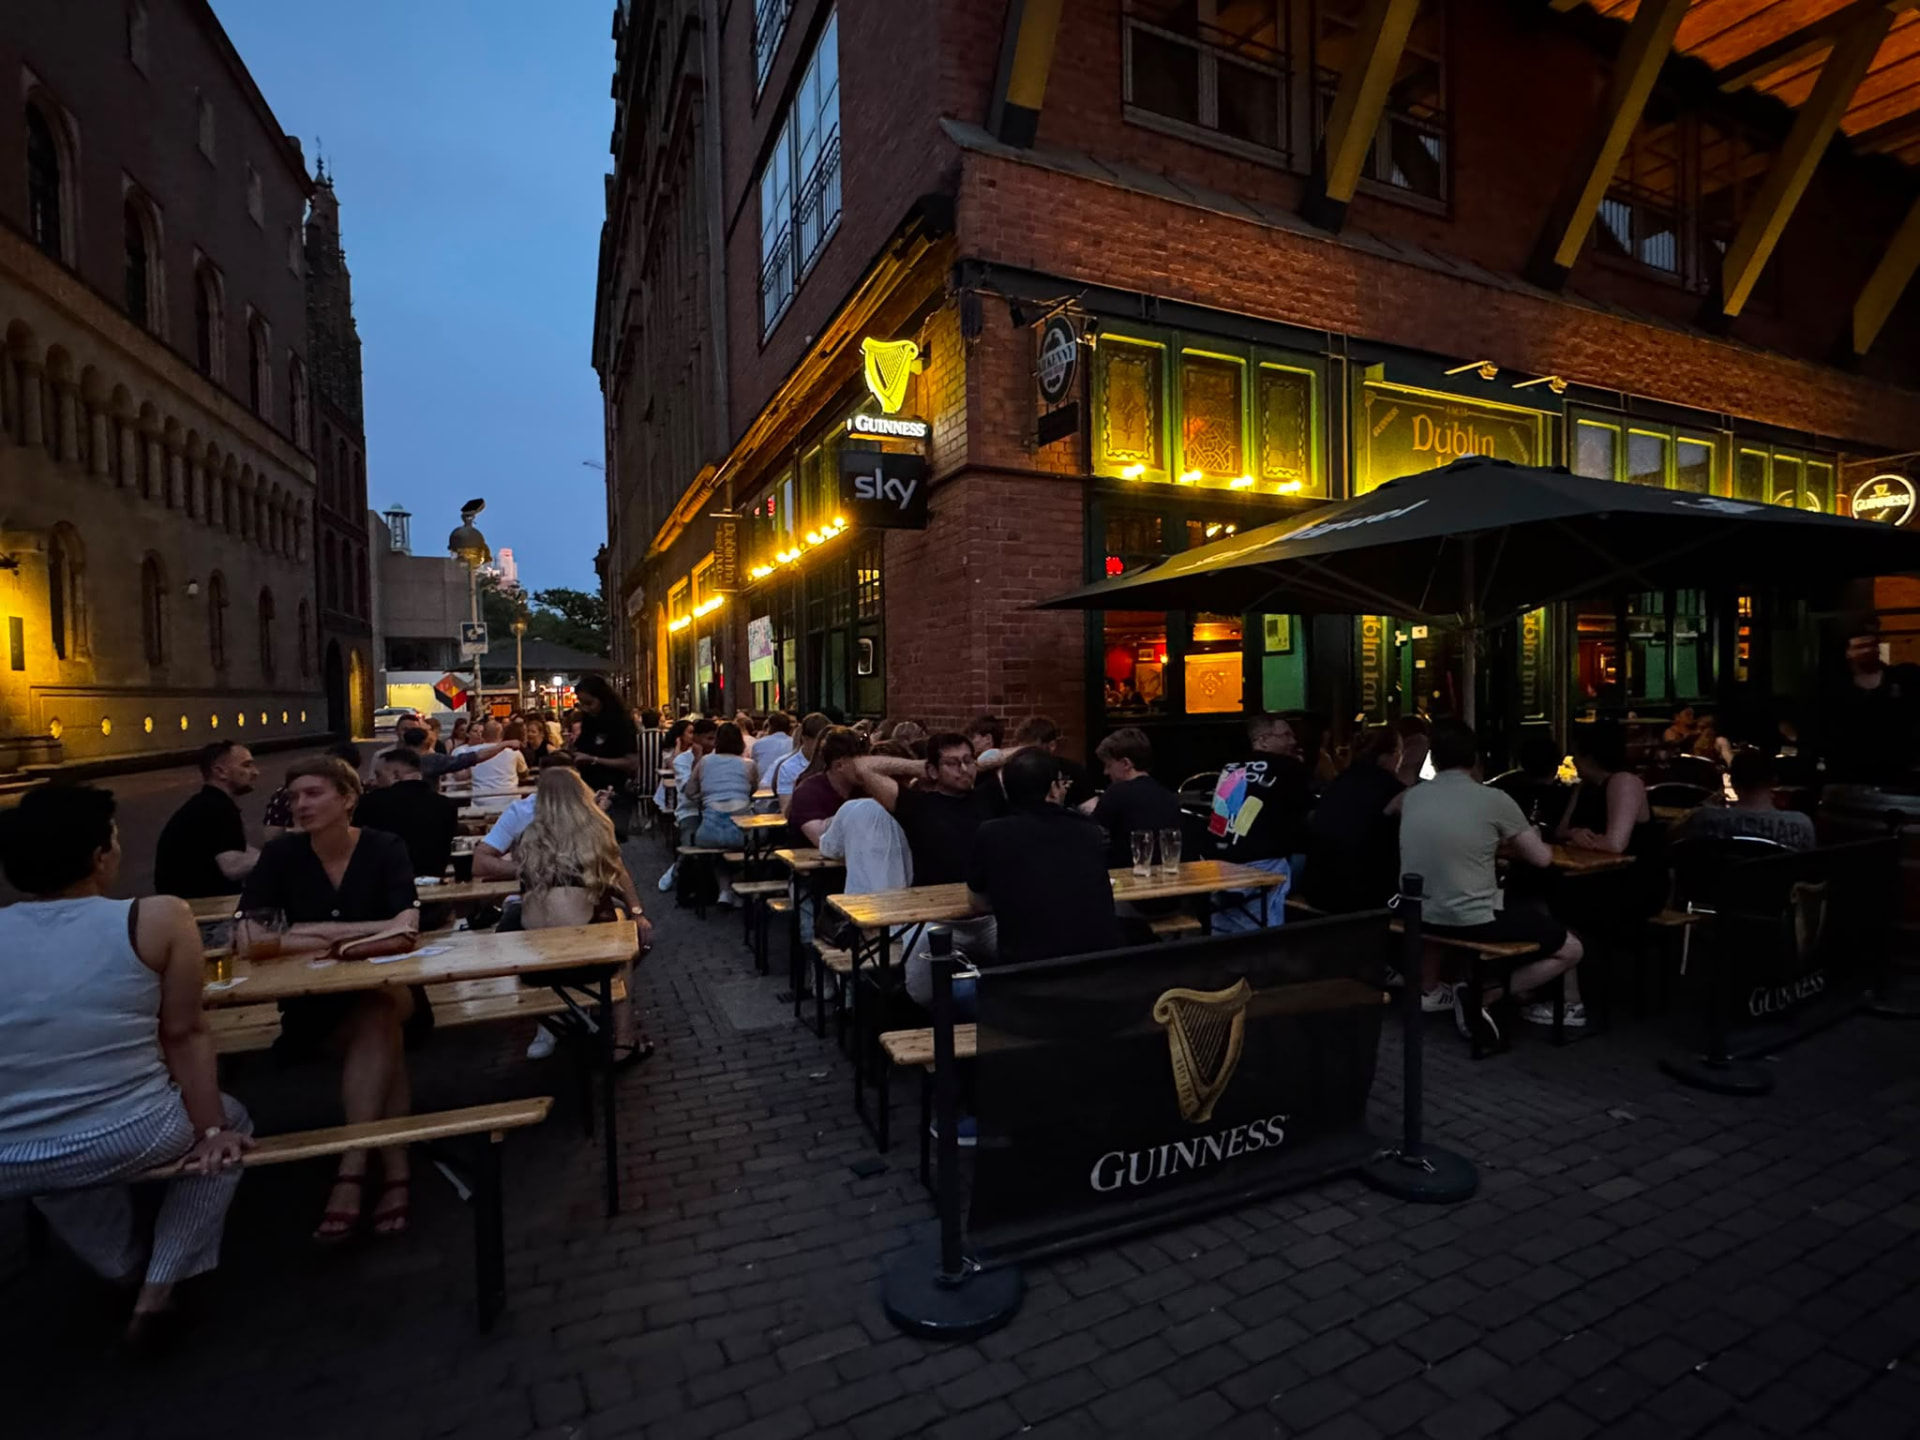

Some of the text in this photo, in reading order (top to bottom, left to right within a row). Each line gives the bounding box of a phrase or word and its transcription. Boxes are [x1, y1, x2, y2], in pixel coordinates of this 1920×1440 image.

[854, 414, 928, 438] GUINNESS
[1412, 413, 1495, 458] Dublin
[854, 467, 919, 511] sky
[1362, 615, 1381, 666] blin
[1245, 771, 1278, 788] OU
[1090, 1114, 1288, 1192] GUINNESS
